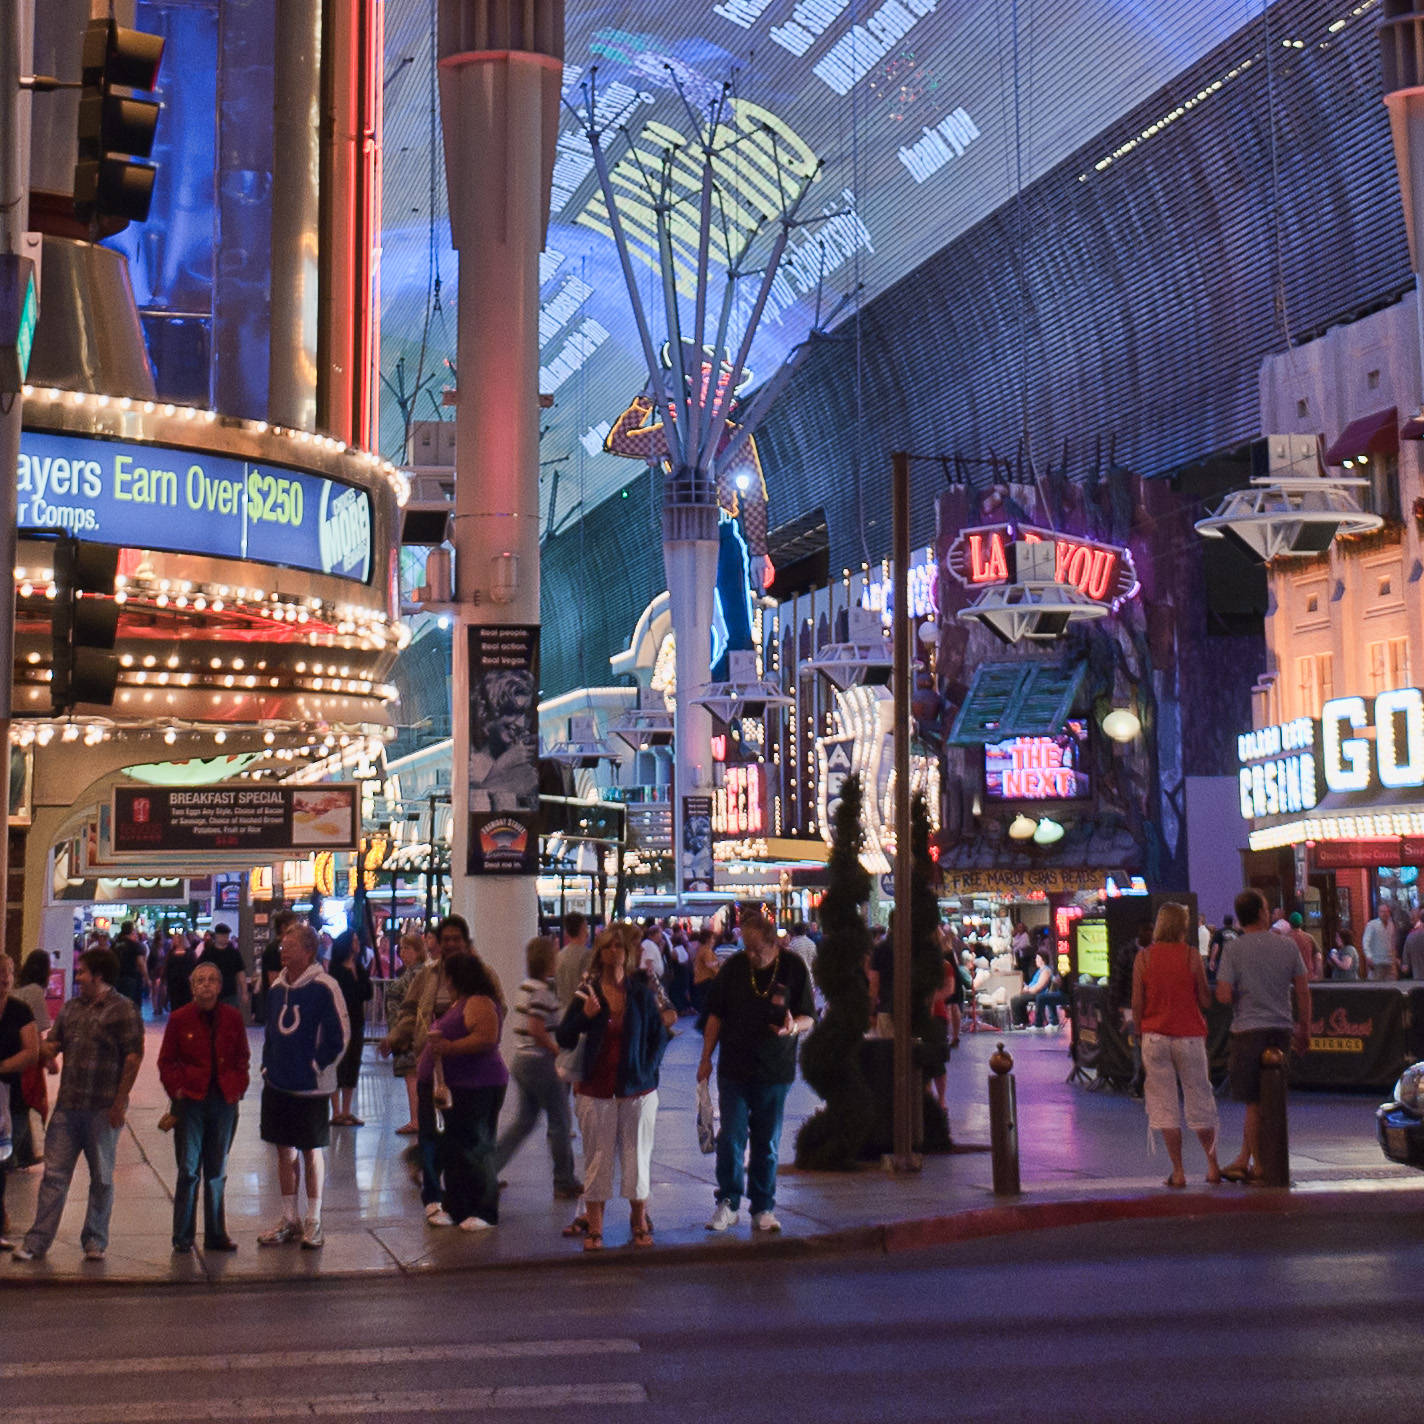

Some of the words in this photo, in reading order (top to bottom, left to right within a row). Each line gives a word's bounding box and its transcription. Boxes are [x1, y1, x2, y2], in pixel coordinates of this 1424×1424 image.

[16, 452, 103, 502] ayers
[114, 455, 178, 506] Earn
[186, 464, 245, 516] Over
[246, 468, 305, 528] $250
[32, 502, 102, 532] Comps.
[969, 533, 1009, 583] LA
[1025, 533, 1116, 600] YOU
[480, 628, 499, 637] Real
[499, 629, 530, 639] people.
[481, 642, 499, 651] Real
[500, 642, 528, 651] action.
[481, 656, 500, 665] Real
[501, 656, 528, 666] Vegas.
[1008, 744, 1064, 769] THE
[1002, 767, 1078, 798] NEXT
[1239, 751, 1317, 820] CASINO
[169, 791, 236, 806] BREAKFAST
[238, 790, 286, 805] SPECIAL
[953, 873, 983, 888] FREE
[986, 870, 1026, 887] MARDI
[1028, 869, 1058, 885] GRAS
[1310, 1038, 1362, 1051] RIENCE
